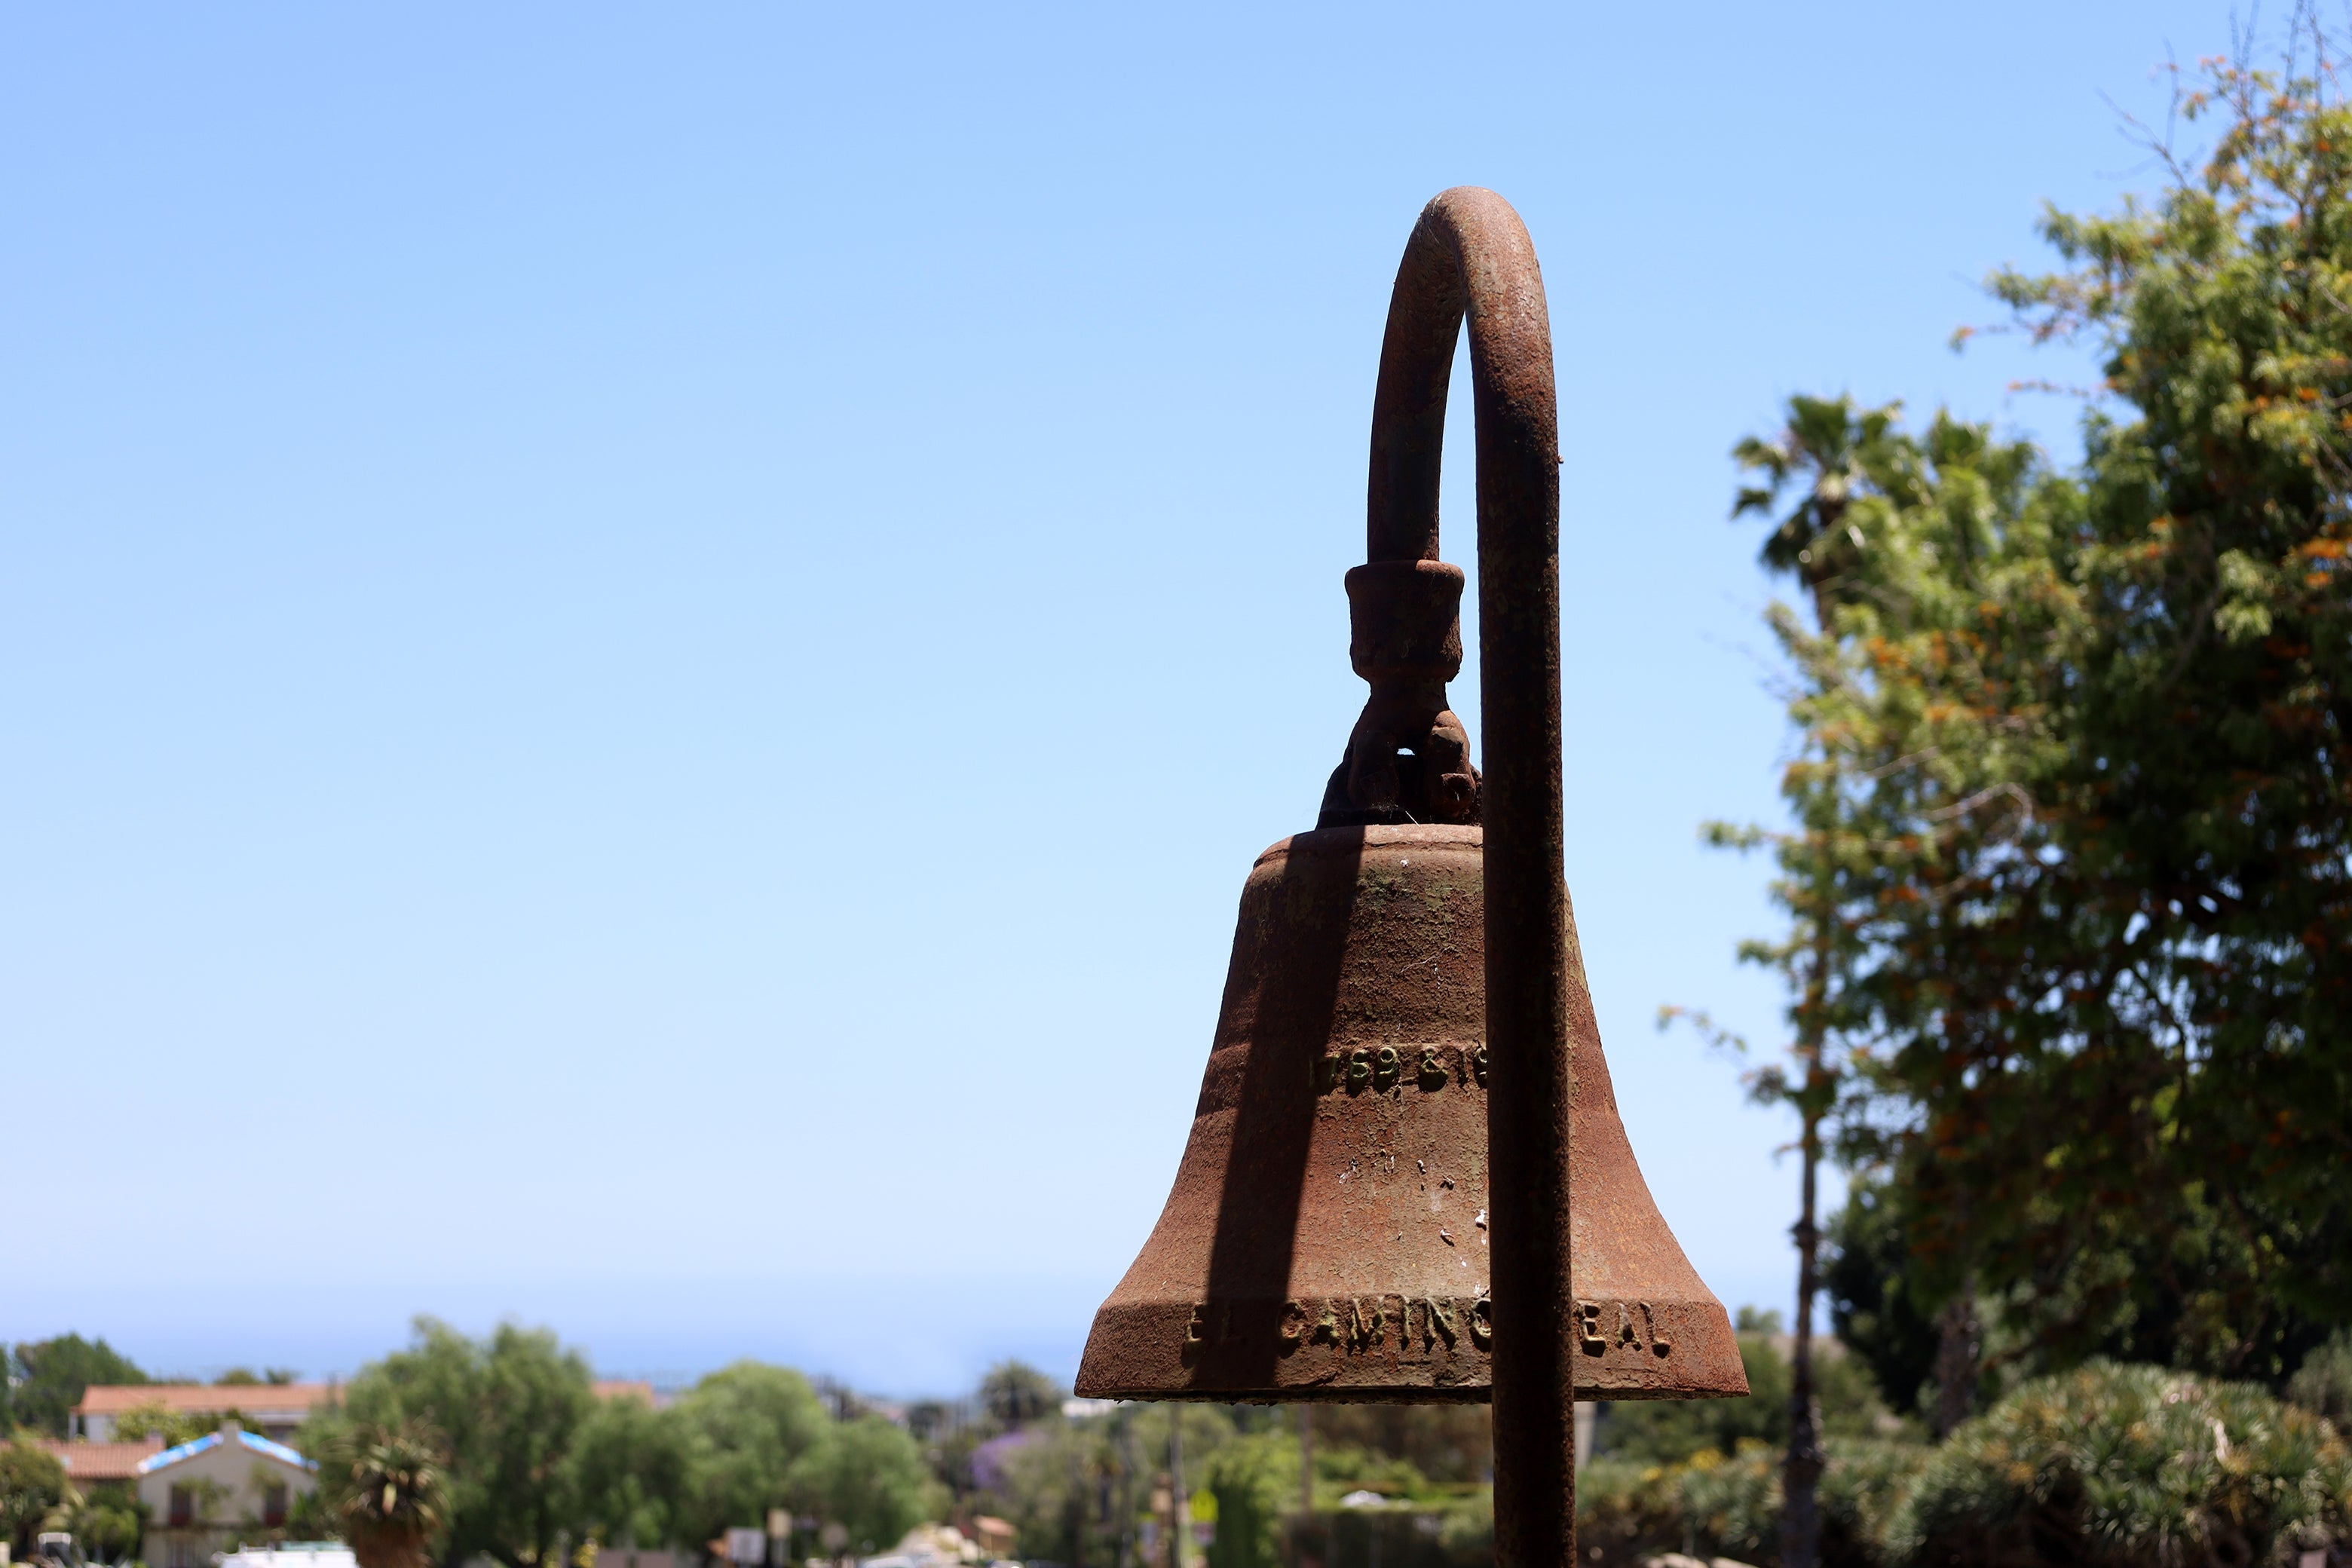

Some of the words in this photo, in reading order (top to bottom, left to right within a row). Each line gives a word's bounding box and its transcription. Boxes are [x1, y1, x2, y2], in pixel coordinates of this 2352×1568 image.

[1419, 1046, 1448, 1081] &
[1456, 1046, 1487, 1083] 19
[1275, 1296, 1491, 1348] CAMINO
[1576, 1299, 1670, 1350] EAL
